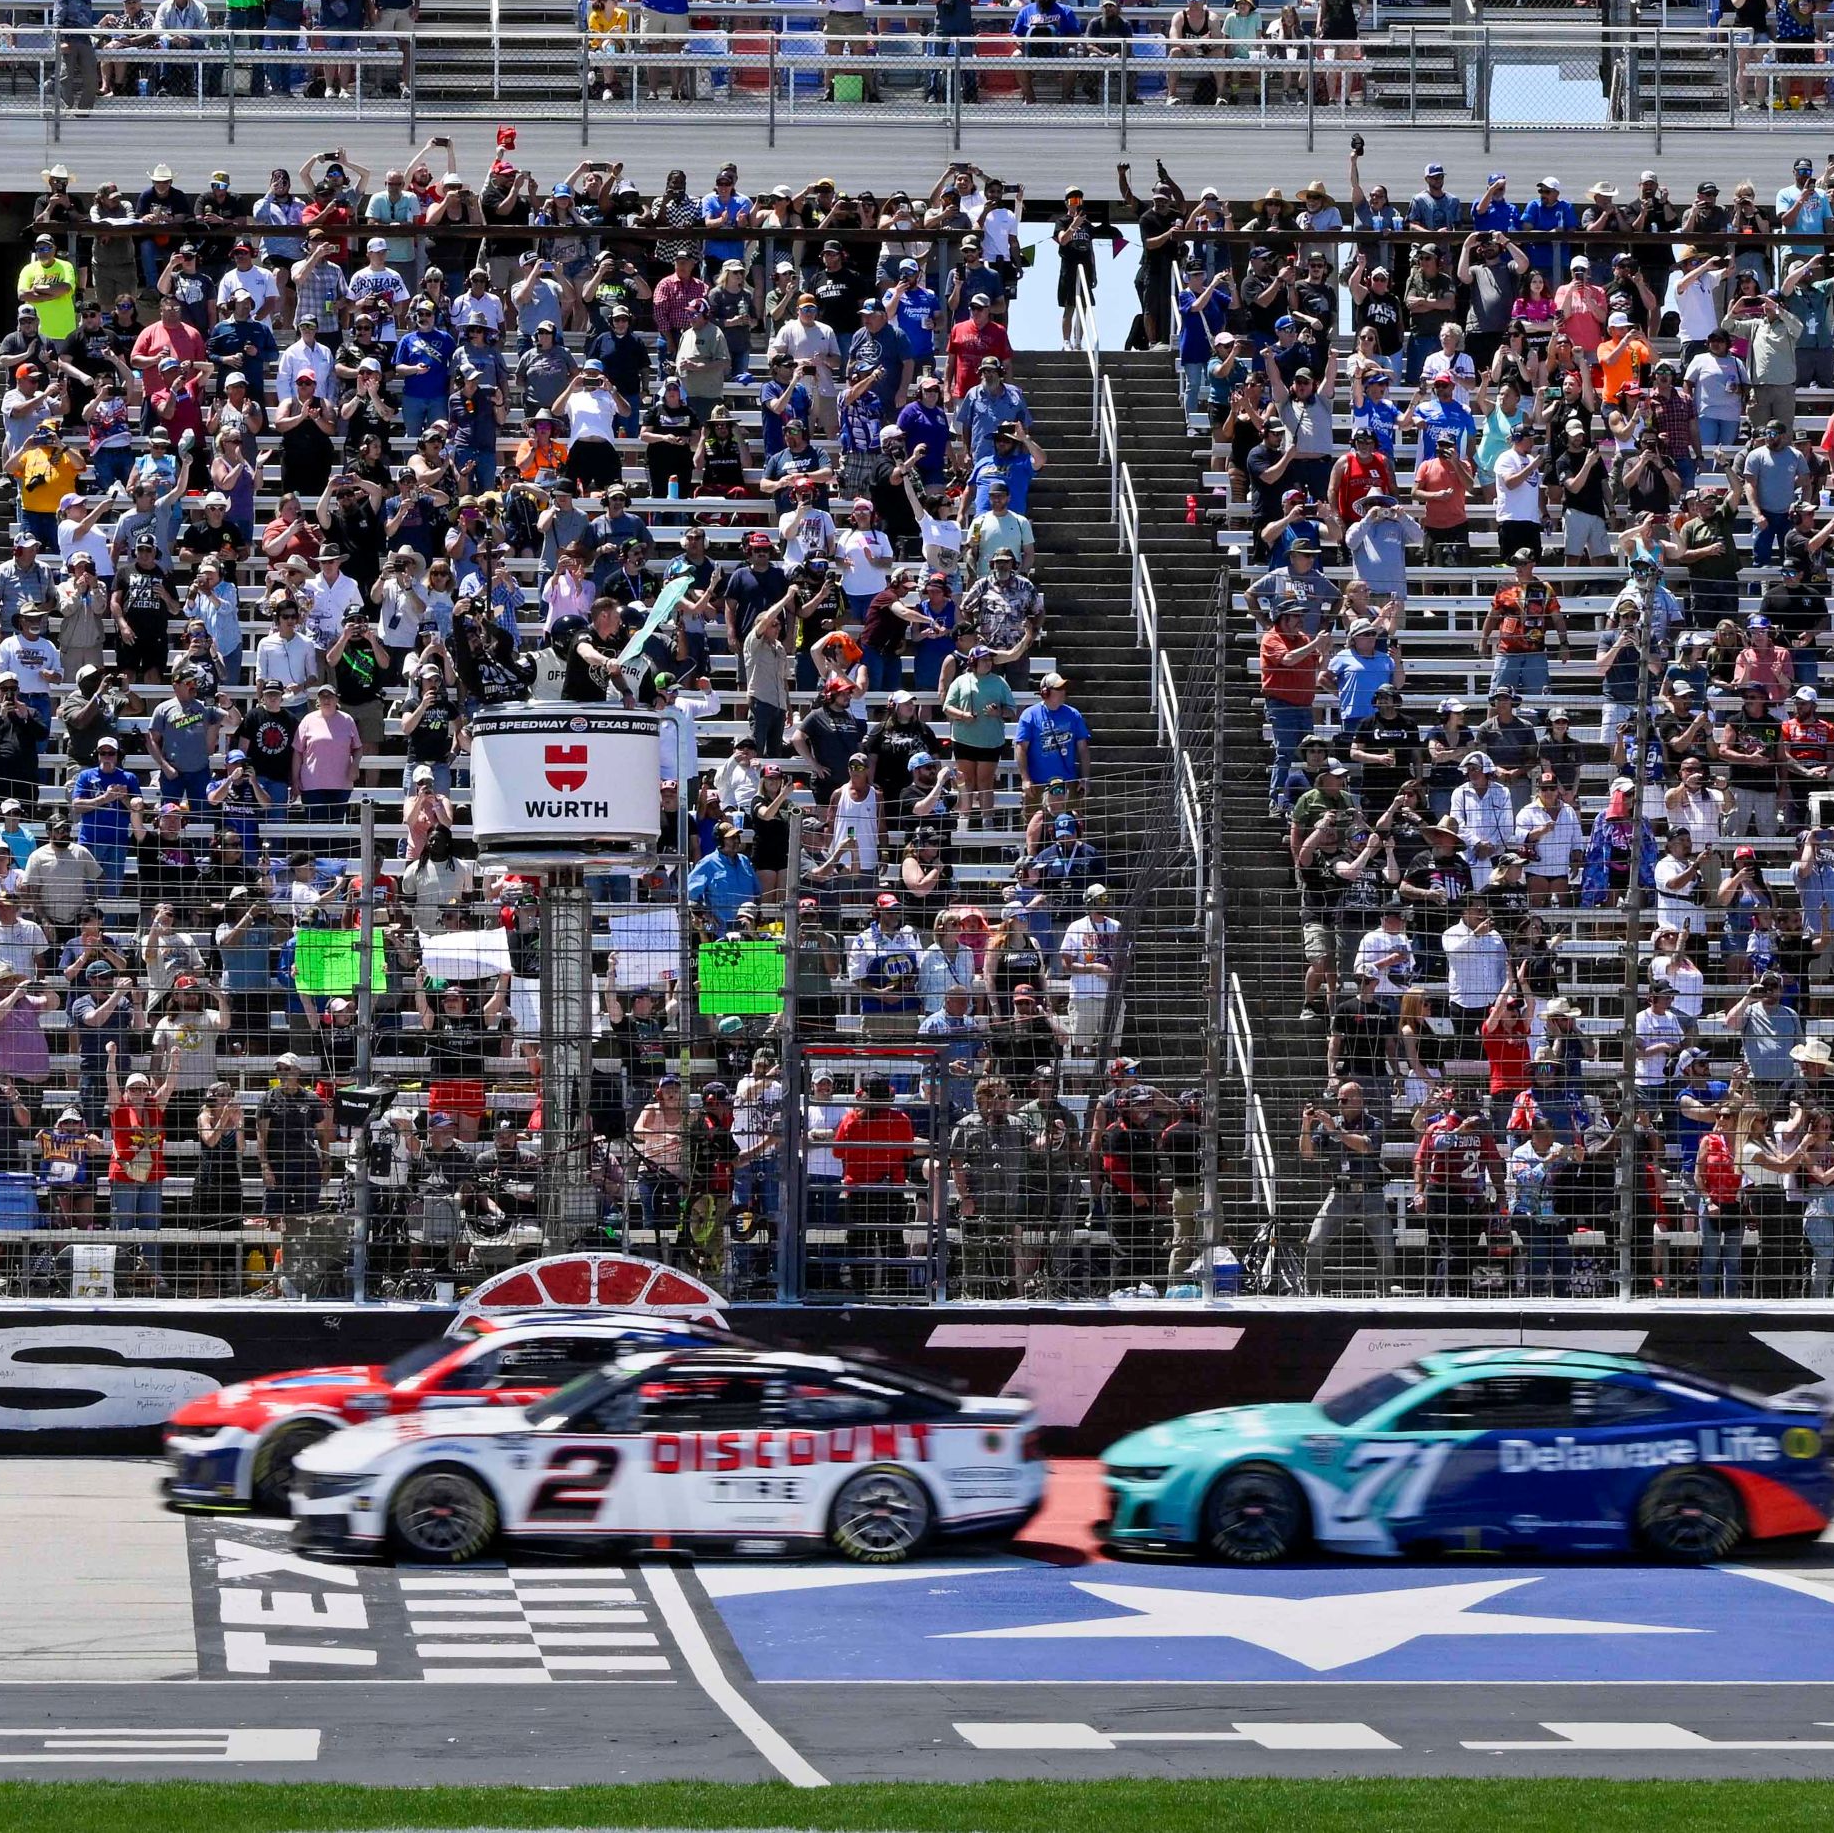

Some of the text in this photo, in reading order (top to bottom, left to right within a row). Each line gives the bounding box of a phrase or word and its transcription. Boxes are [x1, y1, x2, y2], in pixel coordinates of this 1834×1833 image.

[904, 305, 930, 316] Hendrick
[1368, 302, 1396, 320] RACE
[1375, 314, 1389, 324] DAY
[1428, 425, 1460, 437] Hendrick
[781, 458, 810, 470] ASTROS
[1370, 469, 1379, 479] 8
[1285, 582, 1315, 592] BUSCH
[175, 715, 203, 730] BLANEY
[429, 720, 442, 732] 48
[499, 719, 568, 730] SPEEDWAY
[590, 719, 630, 730] TEXAS
[651, 1424, 929, 1474] DISCOUNT
[1498, 1427, 1781, 1473] Delaware Life
[528, 1446, 619, 1522] 2
[1342, 1441, 1453, 1522] 71
[215, 1516, 378, 1673] TEX
